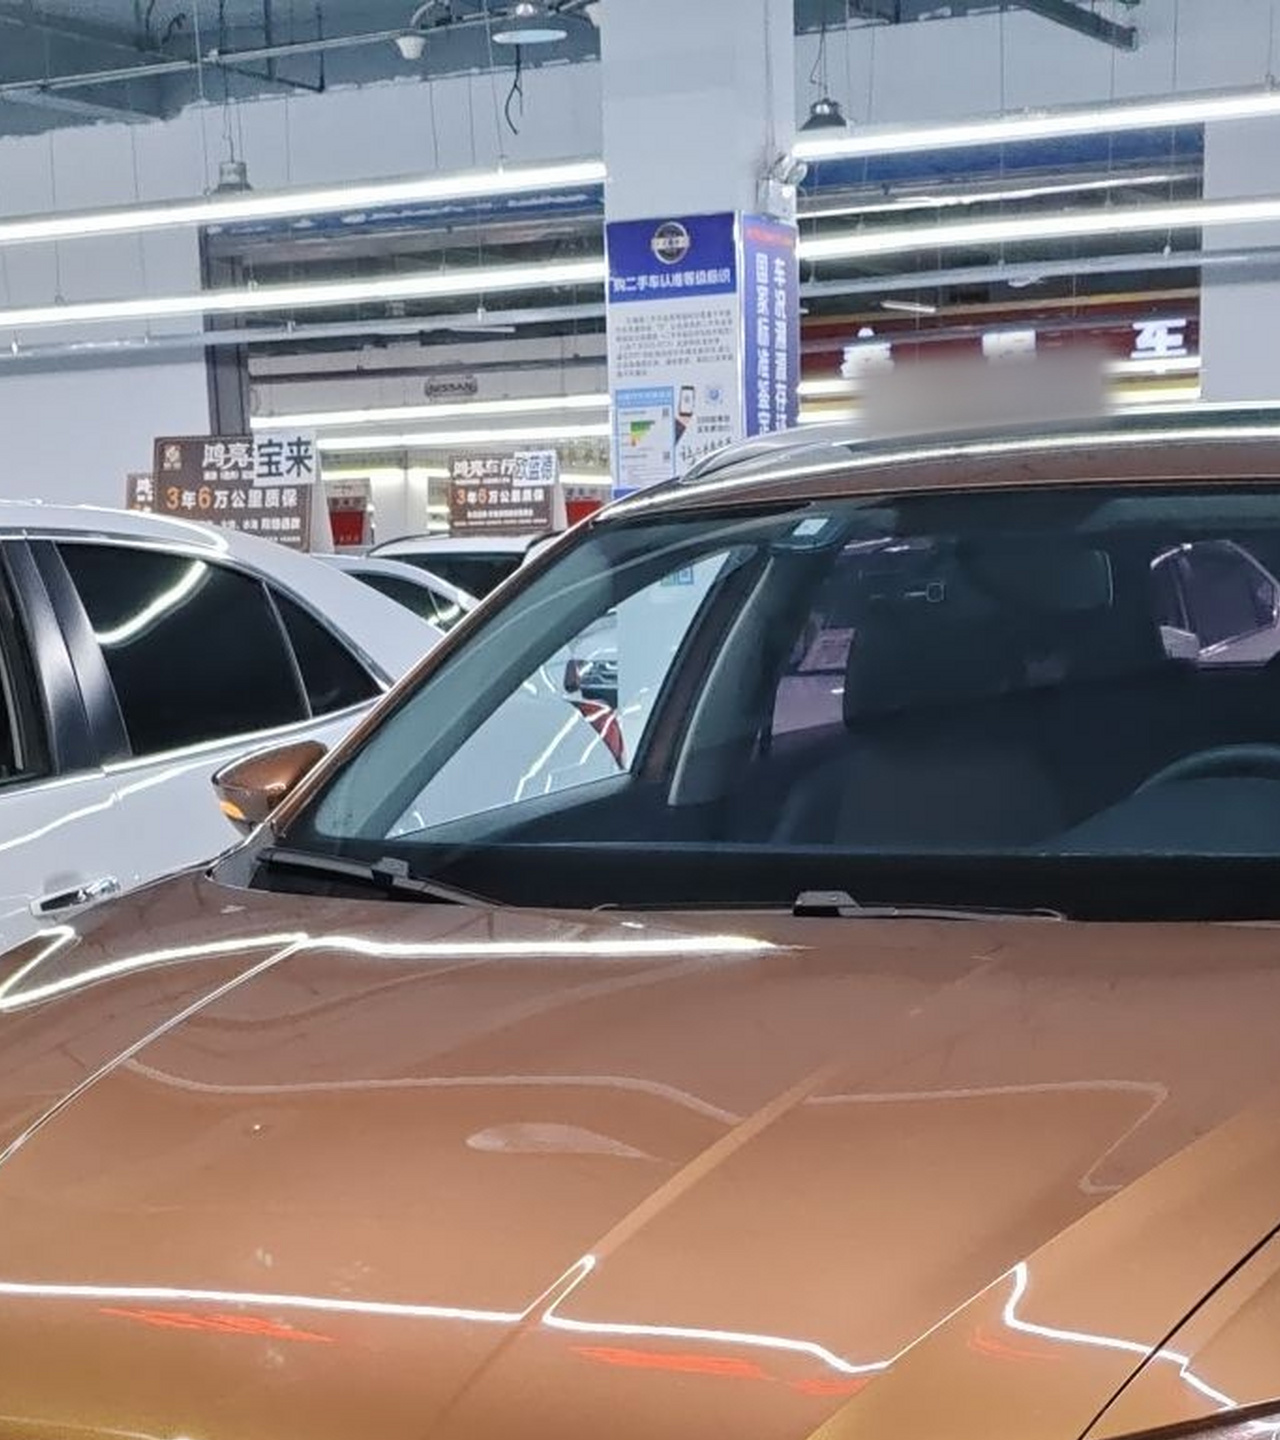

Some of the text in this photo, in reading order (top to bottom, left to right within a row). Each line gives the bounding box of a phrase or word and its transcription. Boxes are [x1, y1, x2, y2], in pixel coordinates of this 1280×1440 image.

[202, 442, 258, 470] 鸿亮
[255, 436, 312, 478] 宝来
[166, 485, 298, 511] 3年6万公里质保
